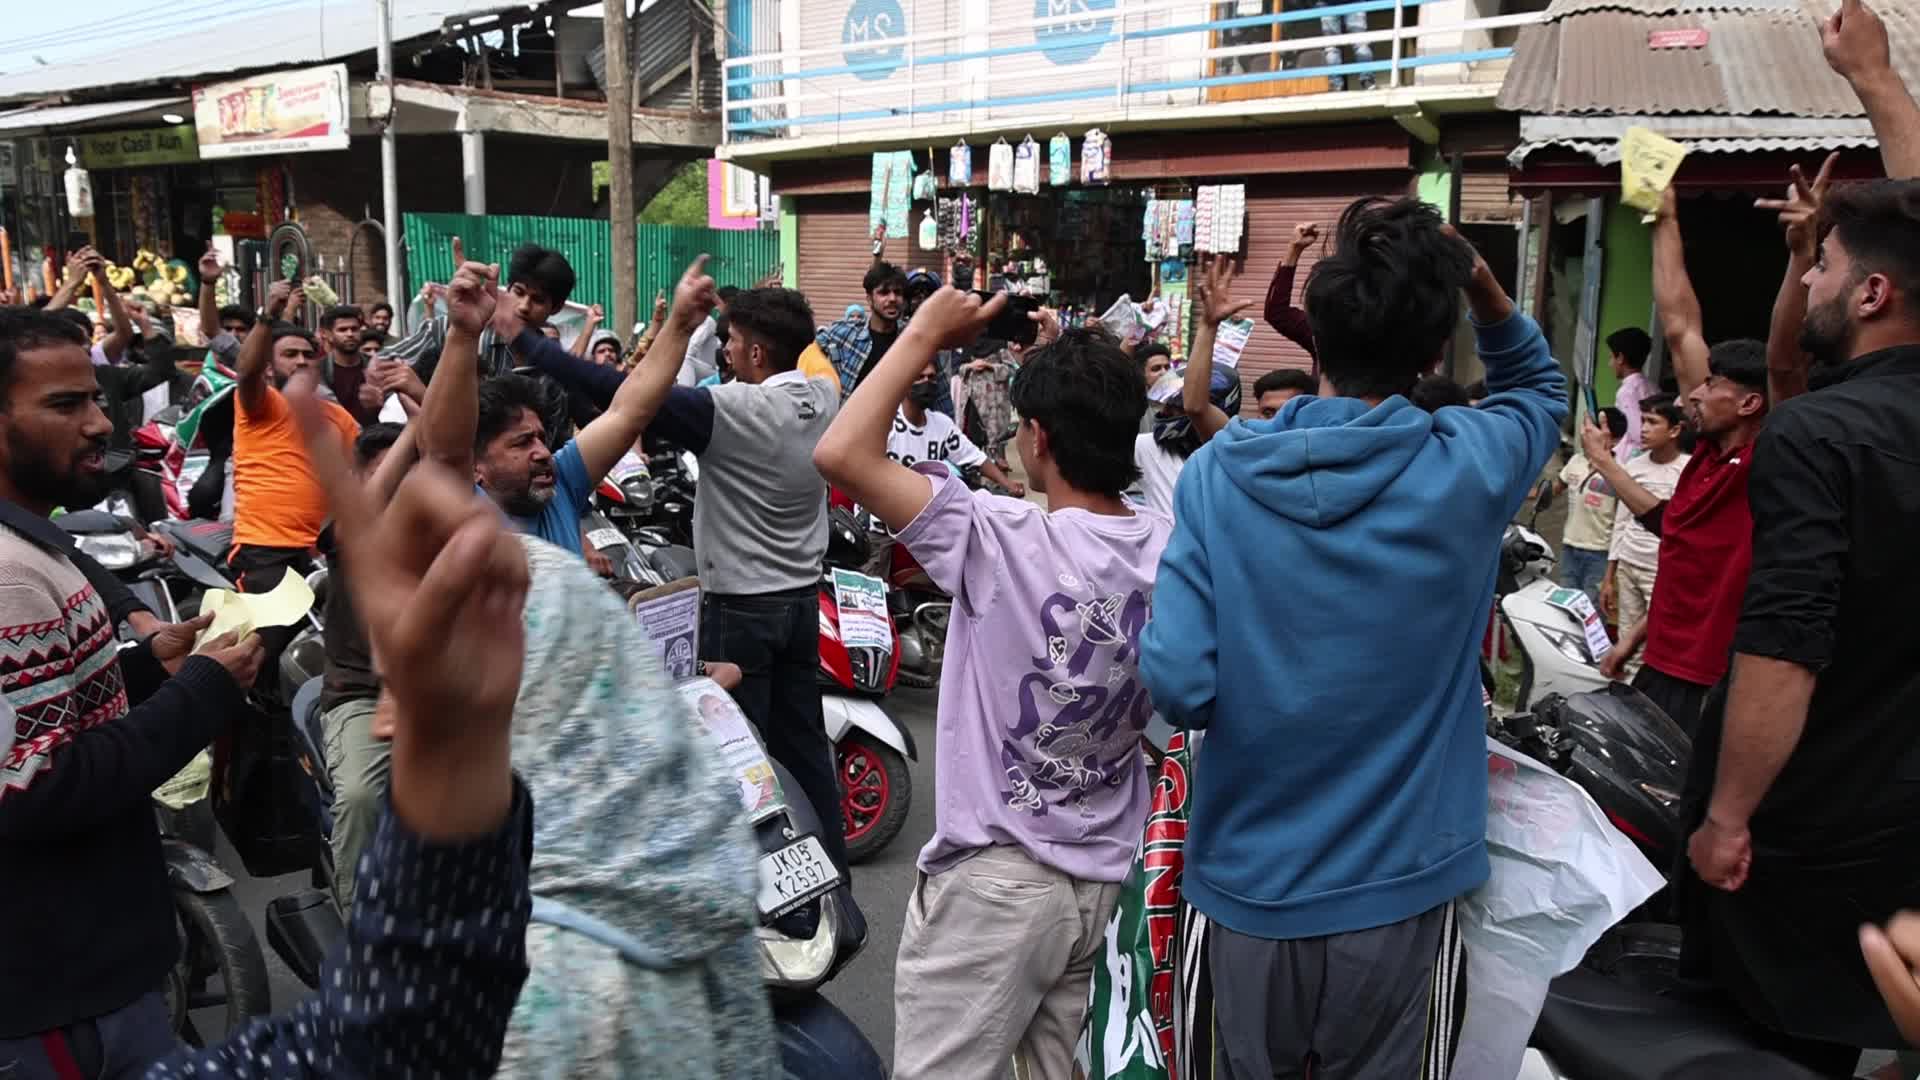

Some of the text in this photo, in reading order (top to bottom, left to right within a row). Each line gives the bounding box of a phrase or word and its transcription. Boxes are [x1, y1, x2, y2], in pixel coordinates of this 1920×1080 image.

[850, 13, 892, 56] MS
[771, 842, 812, 876] JK05
[773, 860, 826, 900] K2597
